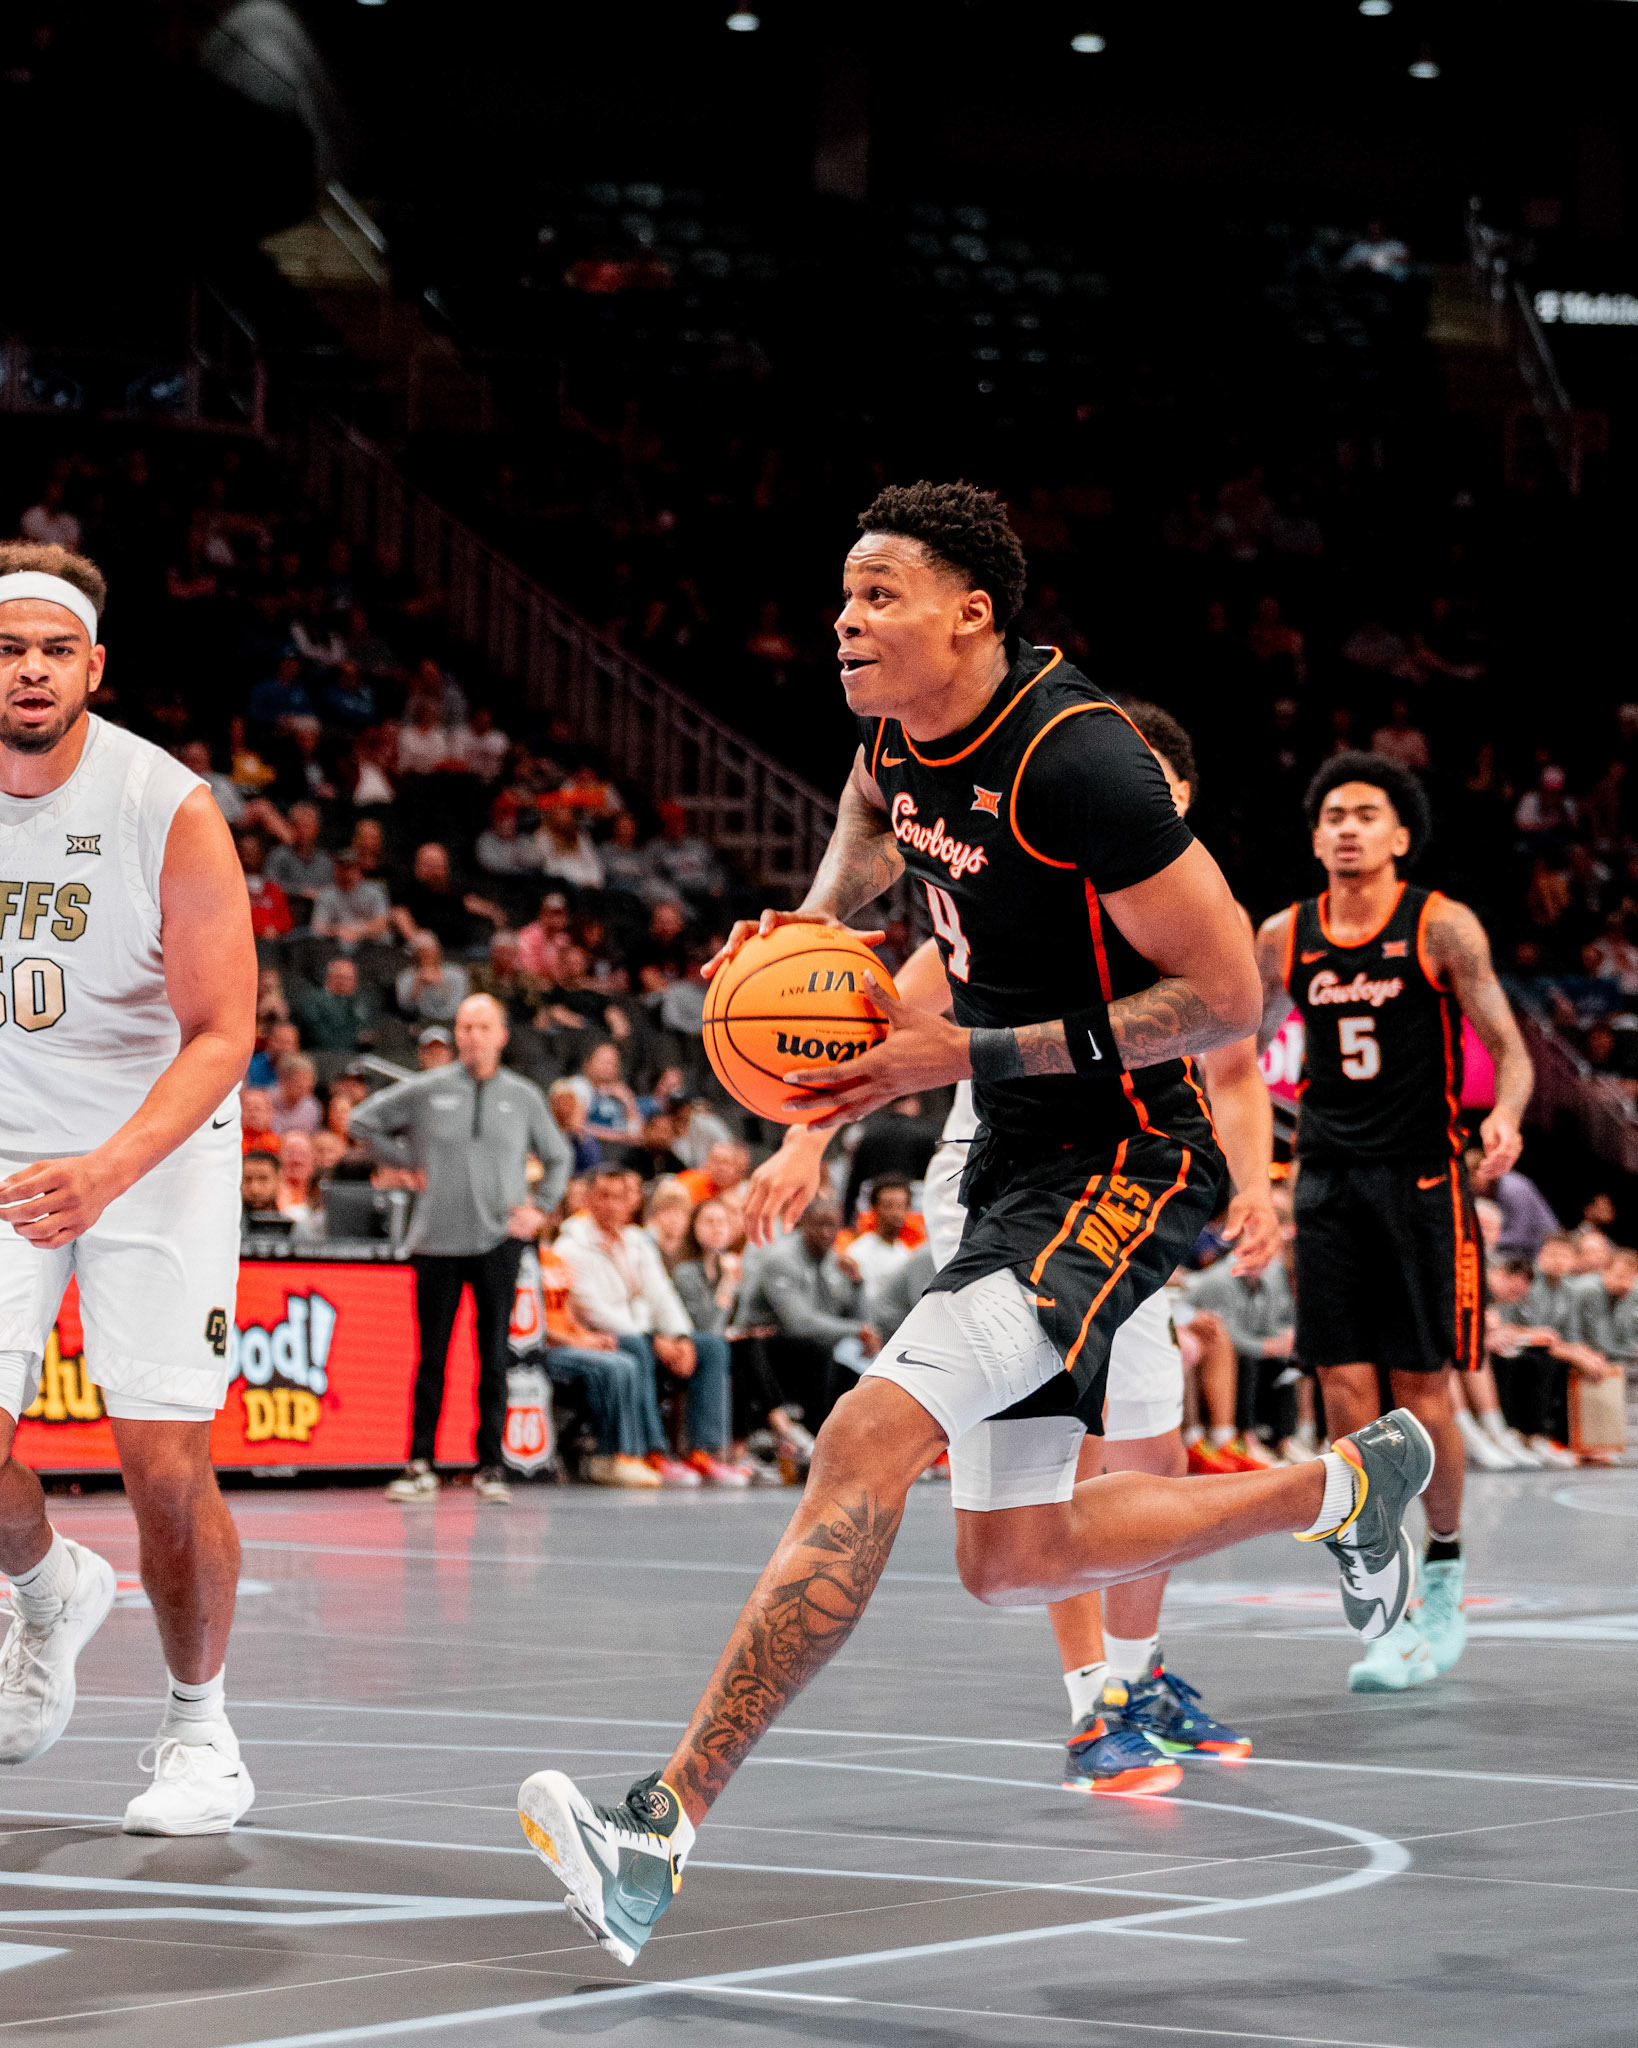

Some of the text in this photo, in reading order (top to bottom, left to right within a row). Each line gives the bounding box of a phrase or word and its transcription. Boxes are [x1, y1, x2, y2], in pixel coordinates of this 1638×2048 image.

[892, 792, 989, 880] Cowboys
[918, 878, 971, 984] 4
[0, 956, 67, 1033] 0
[807, 971, 865, 994] VO
[1337, 1016, 1382, 1081] 5
[1076, 1174, 1151, 1269] POKES
[243, 1387, 321, 1443] DIP
